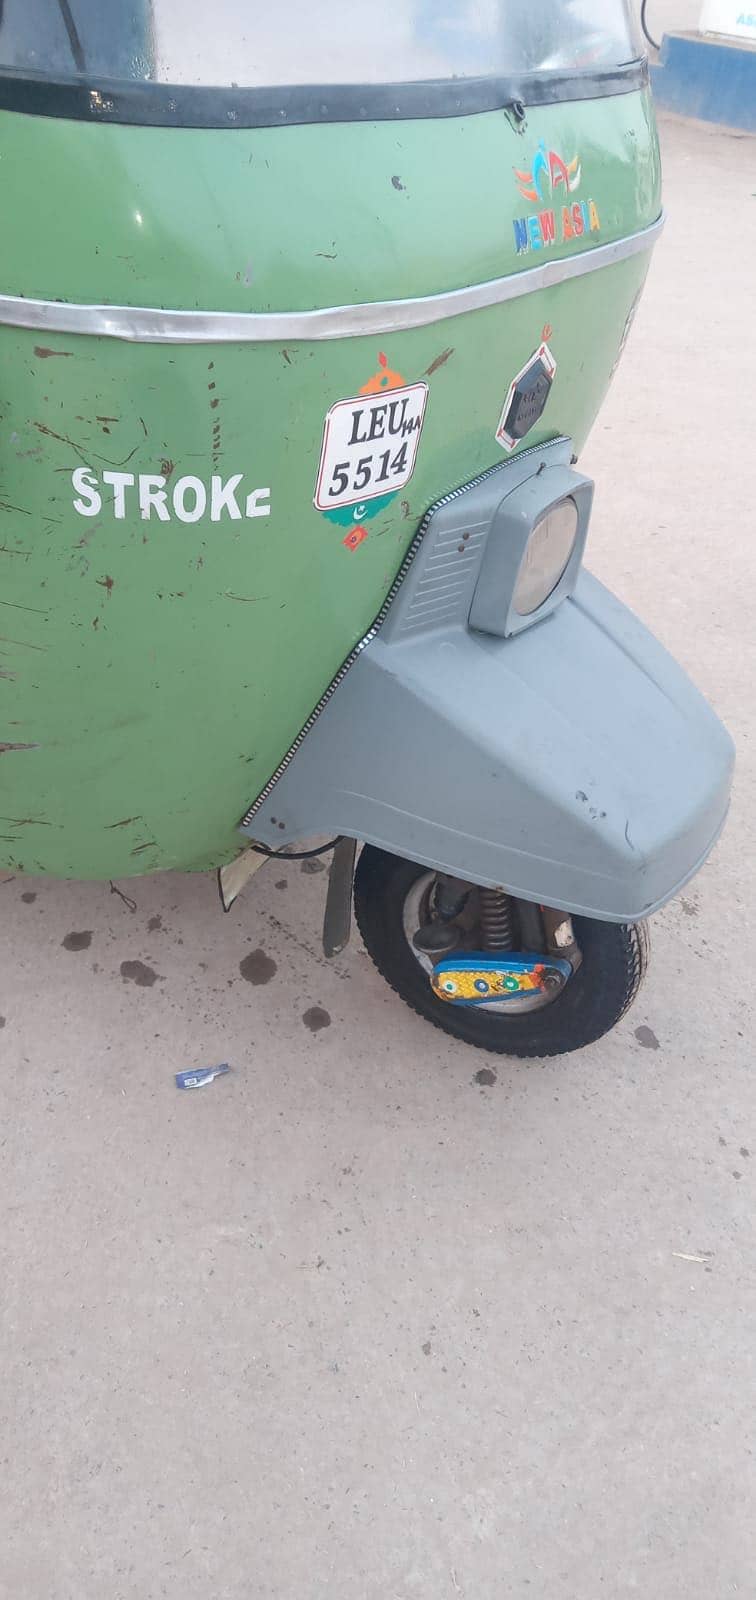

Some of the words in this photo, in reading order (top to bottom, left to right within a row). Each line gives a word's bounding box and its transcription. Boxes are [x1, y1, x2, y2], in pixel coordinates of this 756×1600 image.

[513, 208, 555, 255] NEW
[561, 199, 600, 241] ASIA
[347, 398, 409, 446] LEU
[328, 442, 408, 496] 5514
